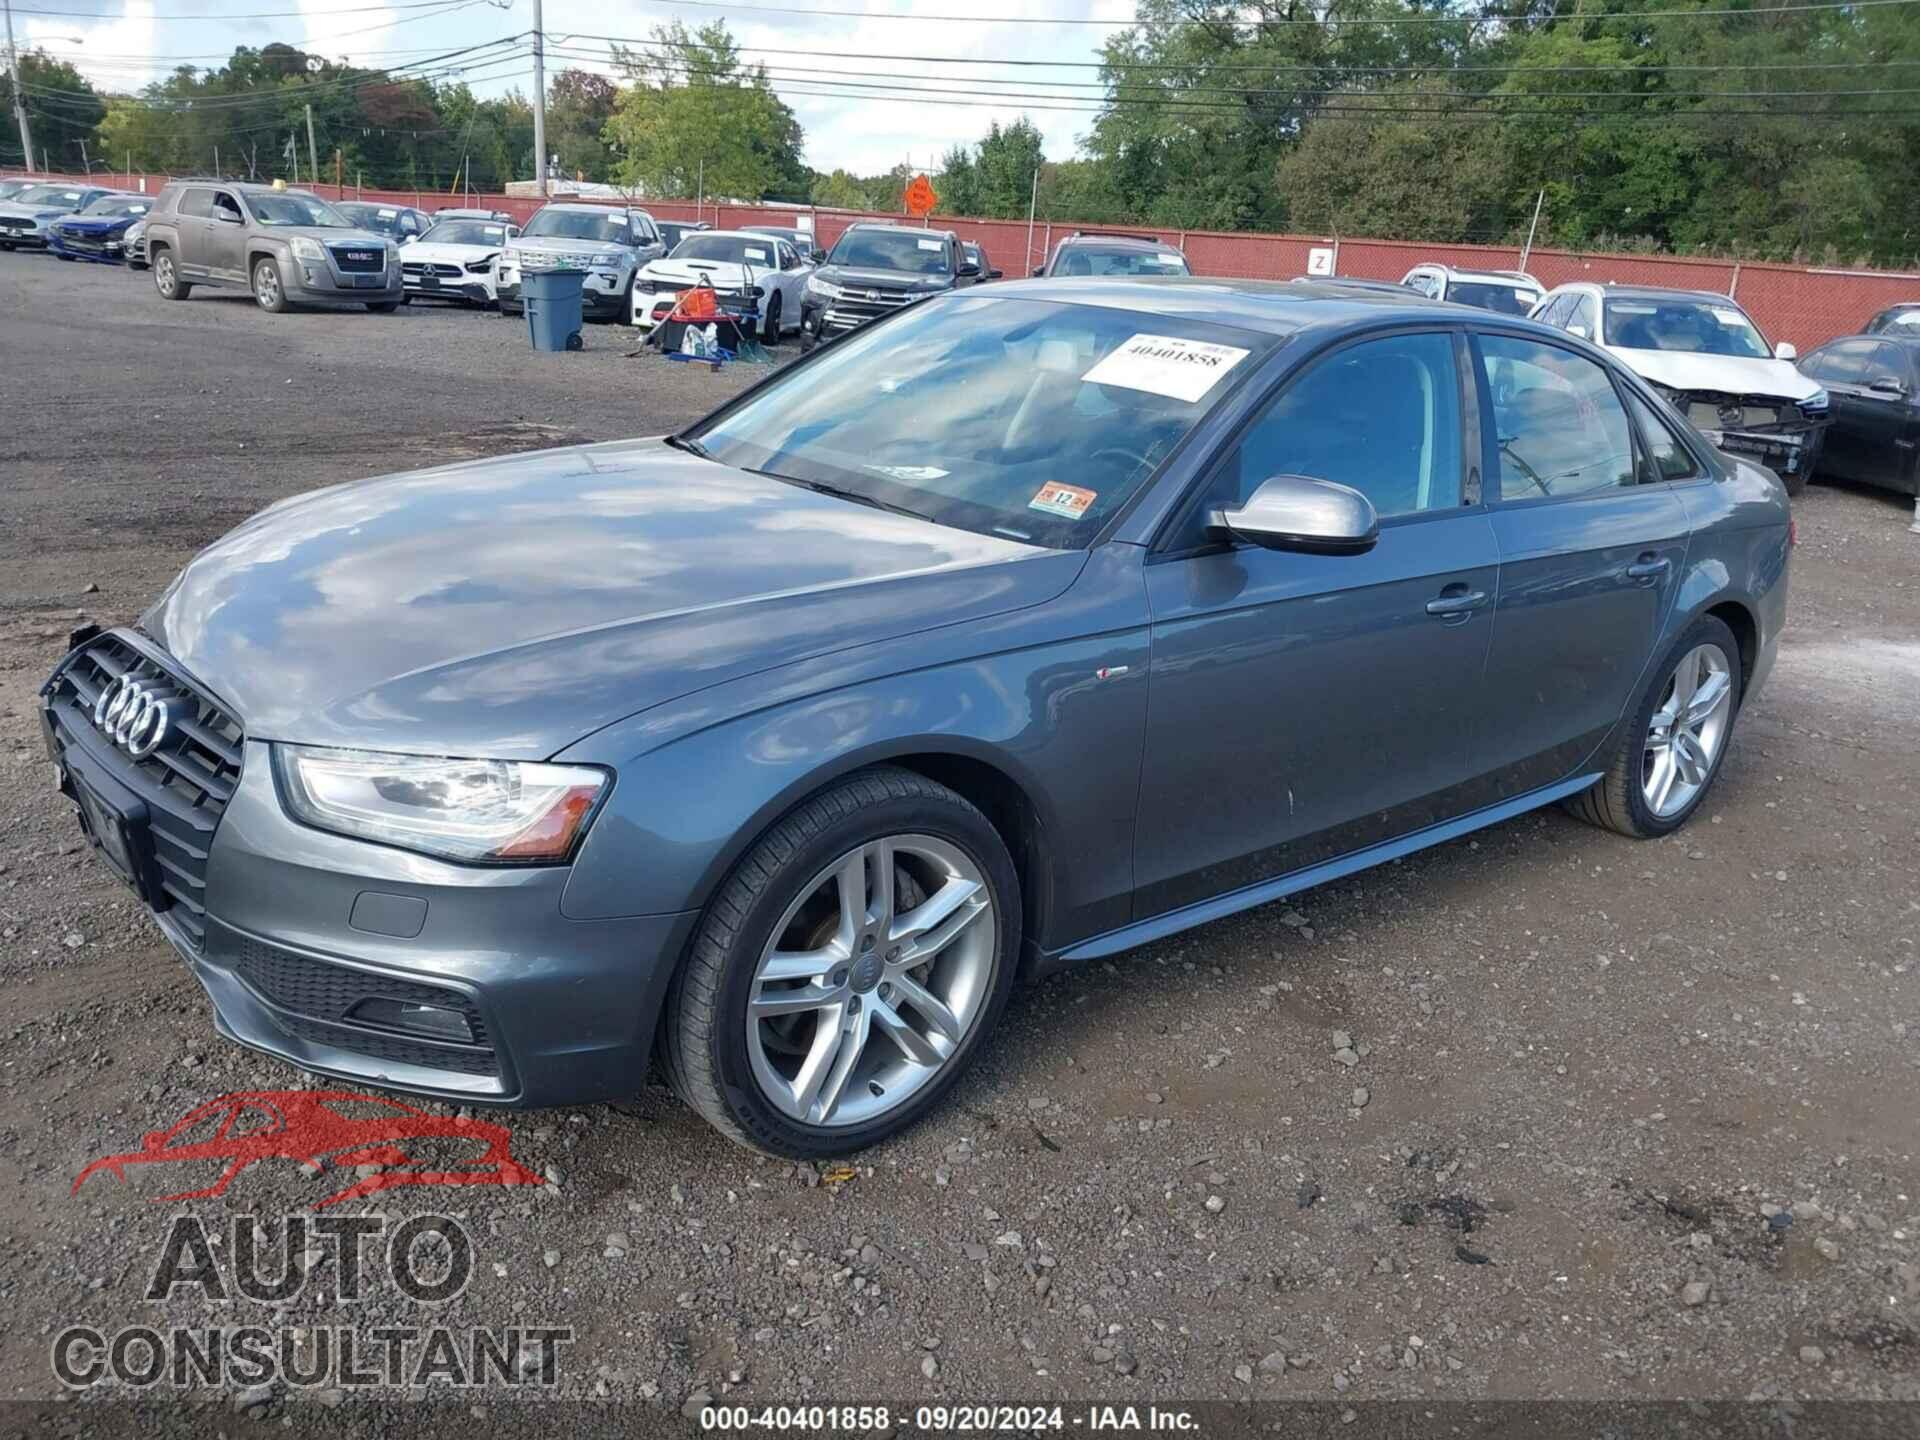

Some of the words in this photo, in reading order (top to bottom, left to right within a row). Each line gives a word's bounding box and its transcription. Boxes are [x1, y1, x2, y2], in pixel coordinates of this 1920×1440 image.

[1315, 255, 1325, 269] Z
[1127, 344, 1222, 368] 40401858
[1056, 492, 1073, 505] 12
